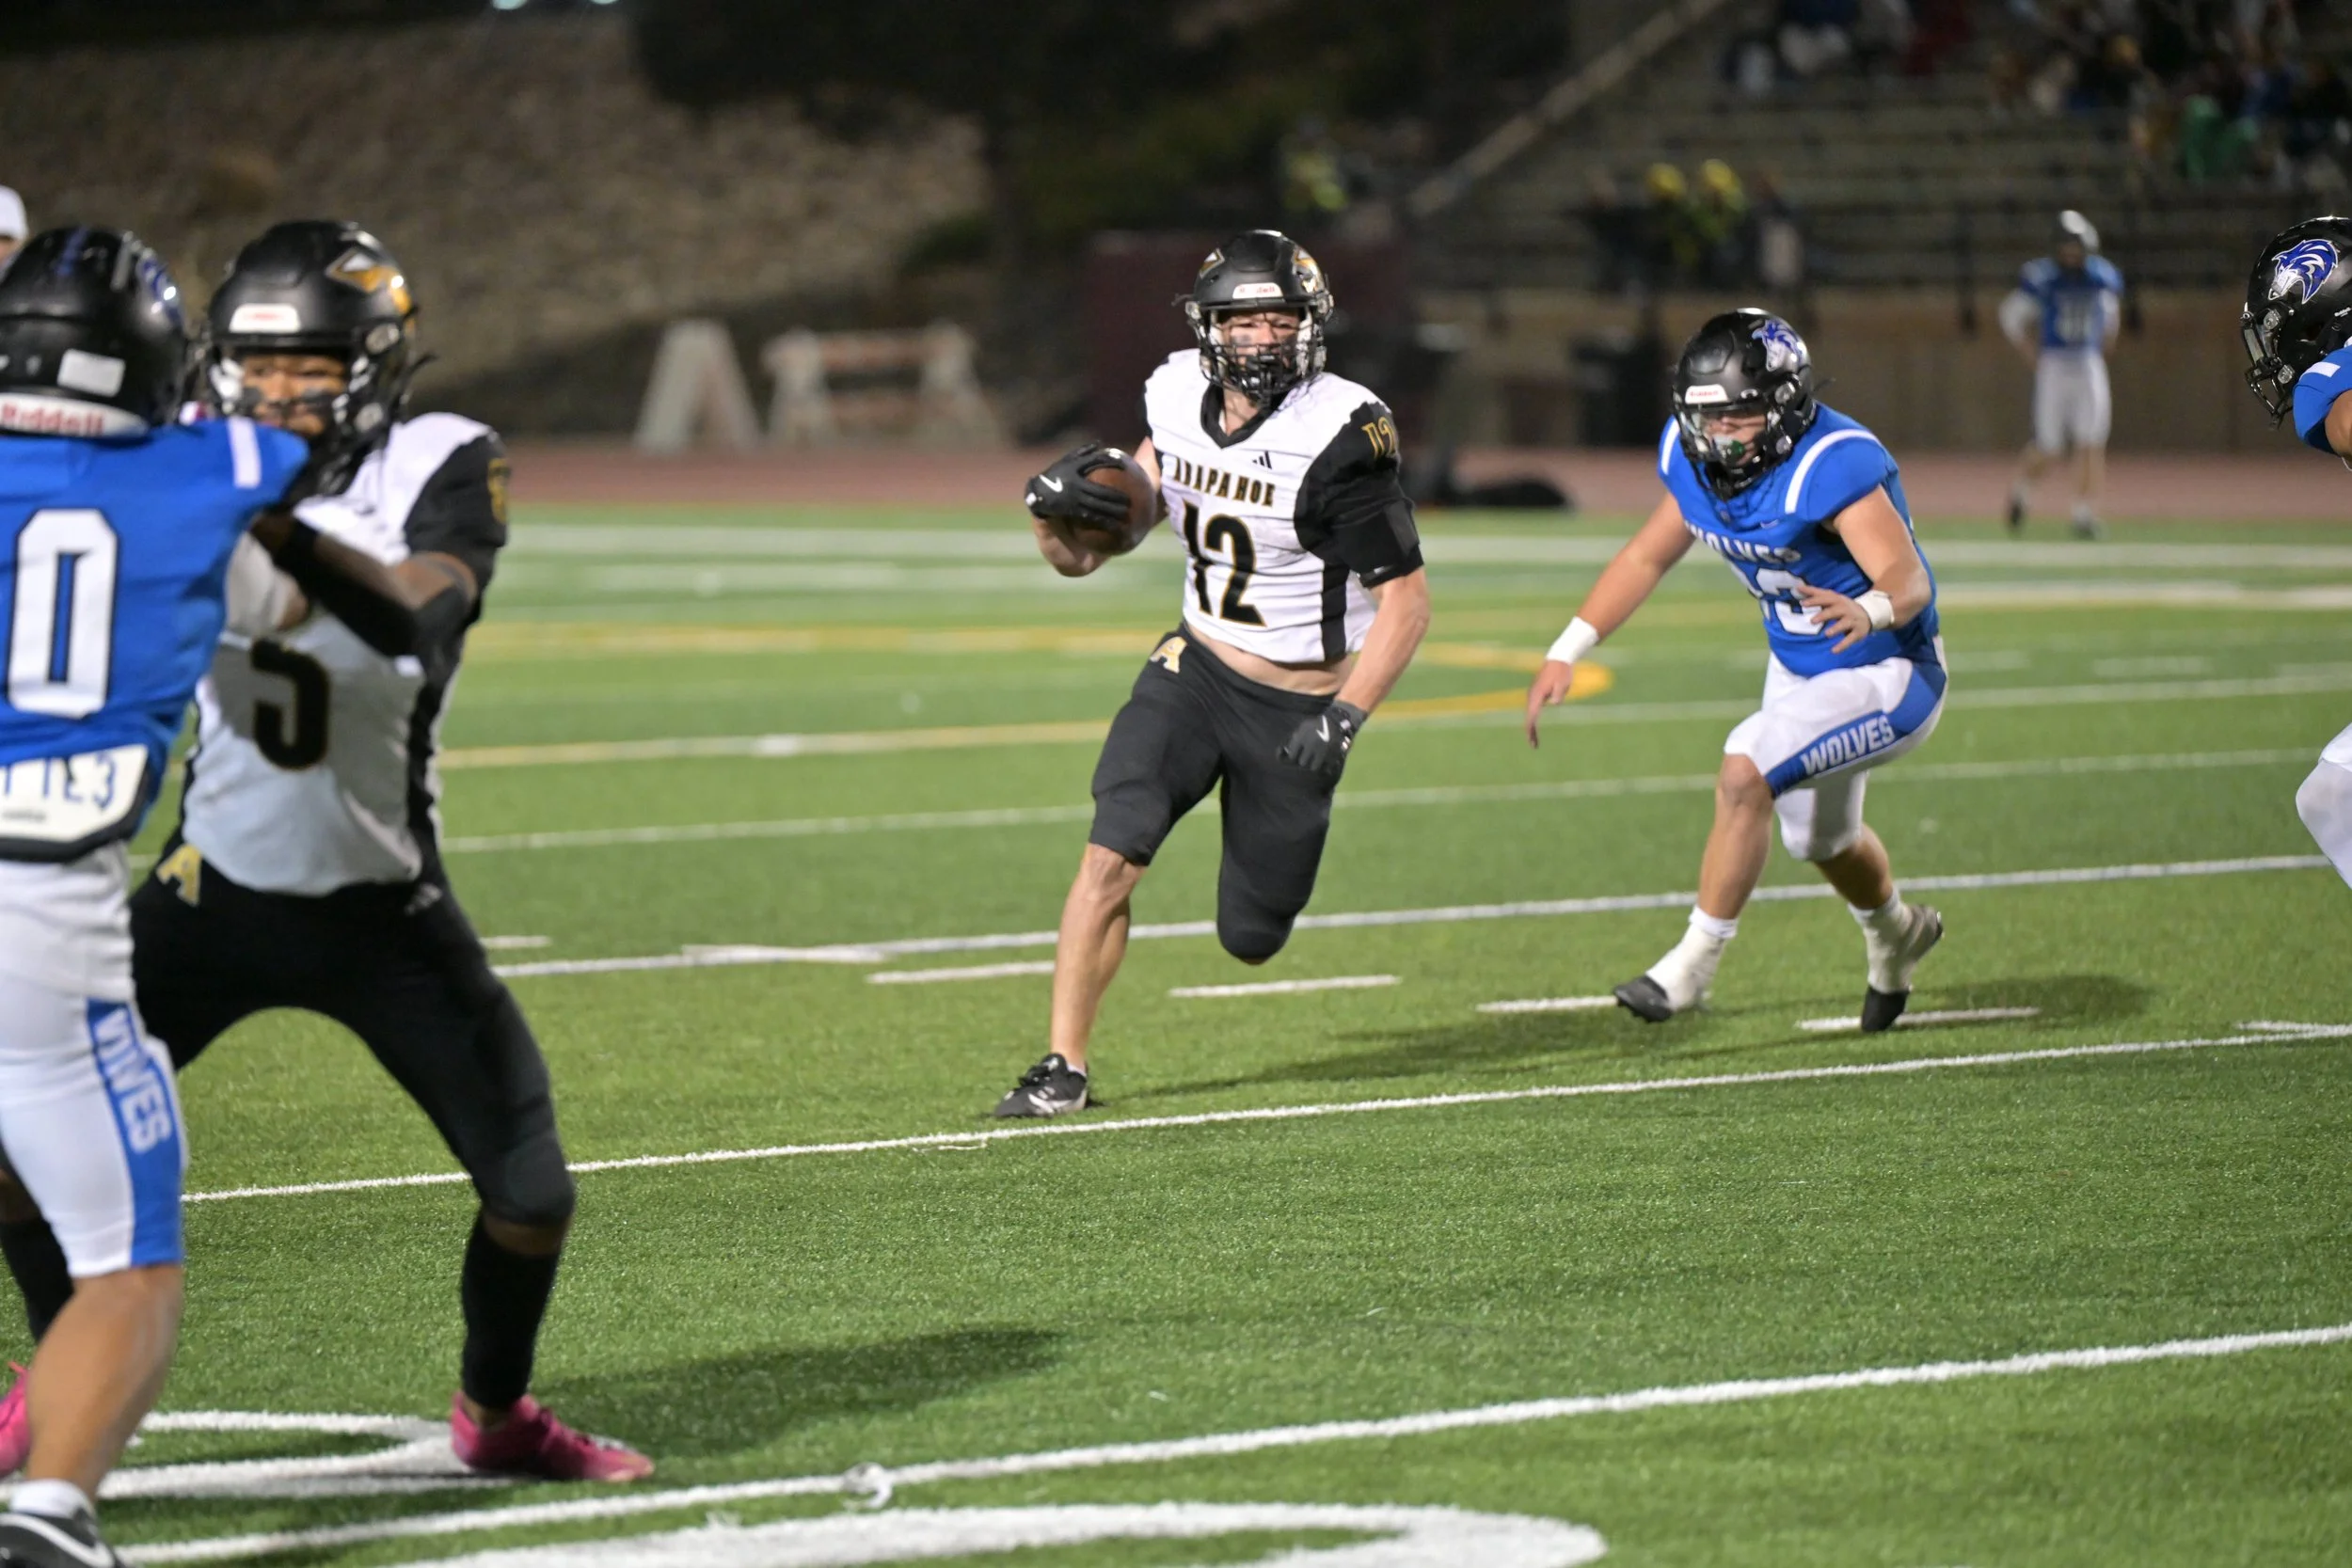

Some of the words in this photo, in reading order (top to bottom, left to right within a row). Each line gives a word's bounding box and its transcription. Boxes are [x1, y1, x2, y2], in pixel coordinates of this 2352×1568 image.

[1183, 499, 1267, 627] 12
[7, 508, 119, 720] 0
[1150, 636, 1187, 673] A
[1800, 715, 1896, 775] WOLVES
